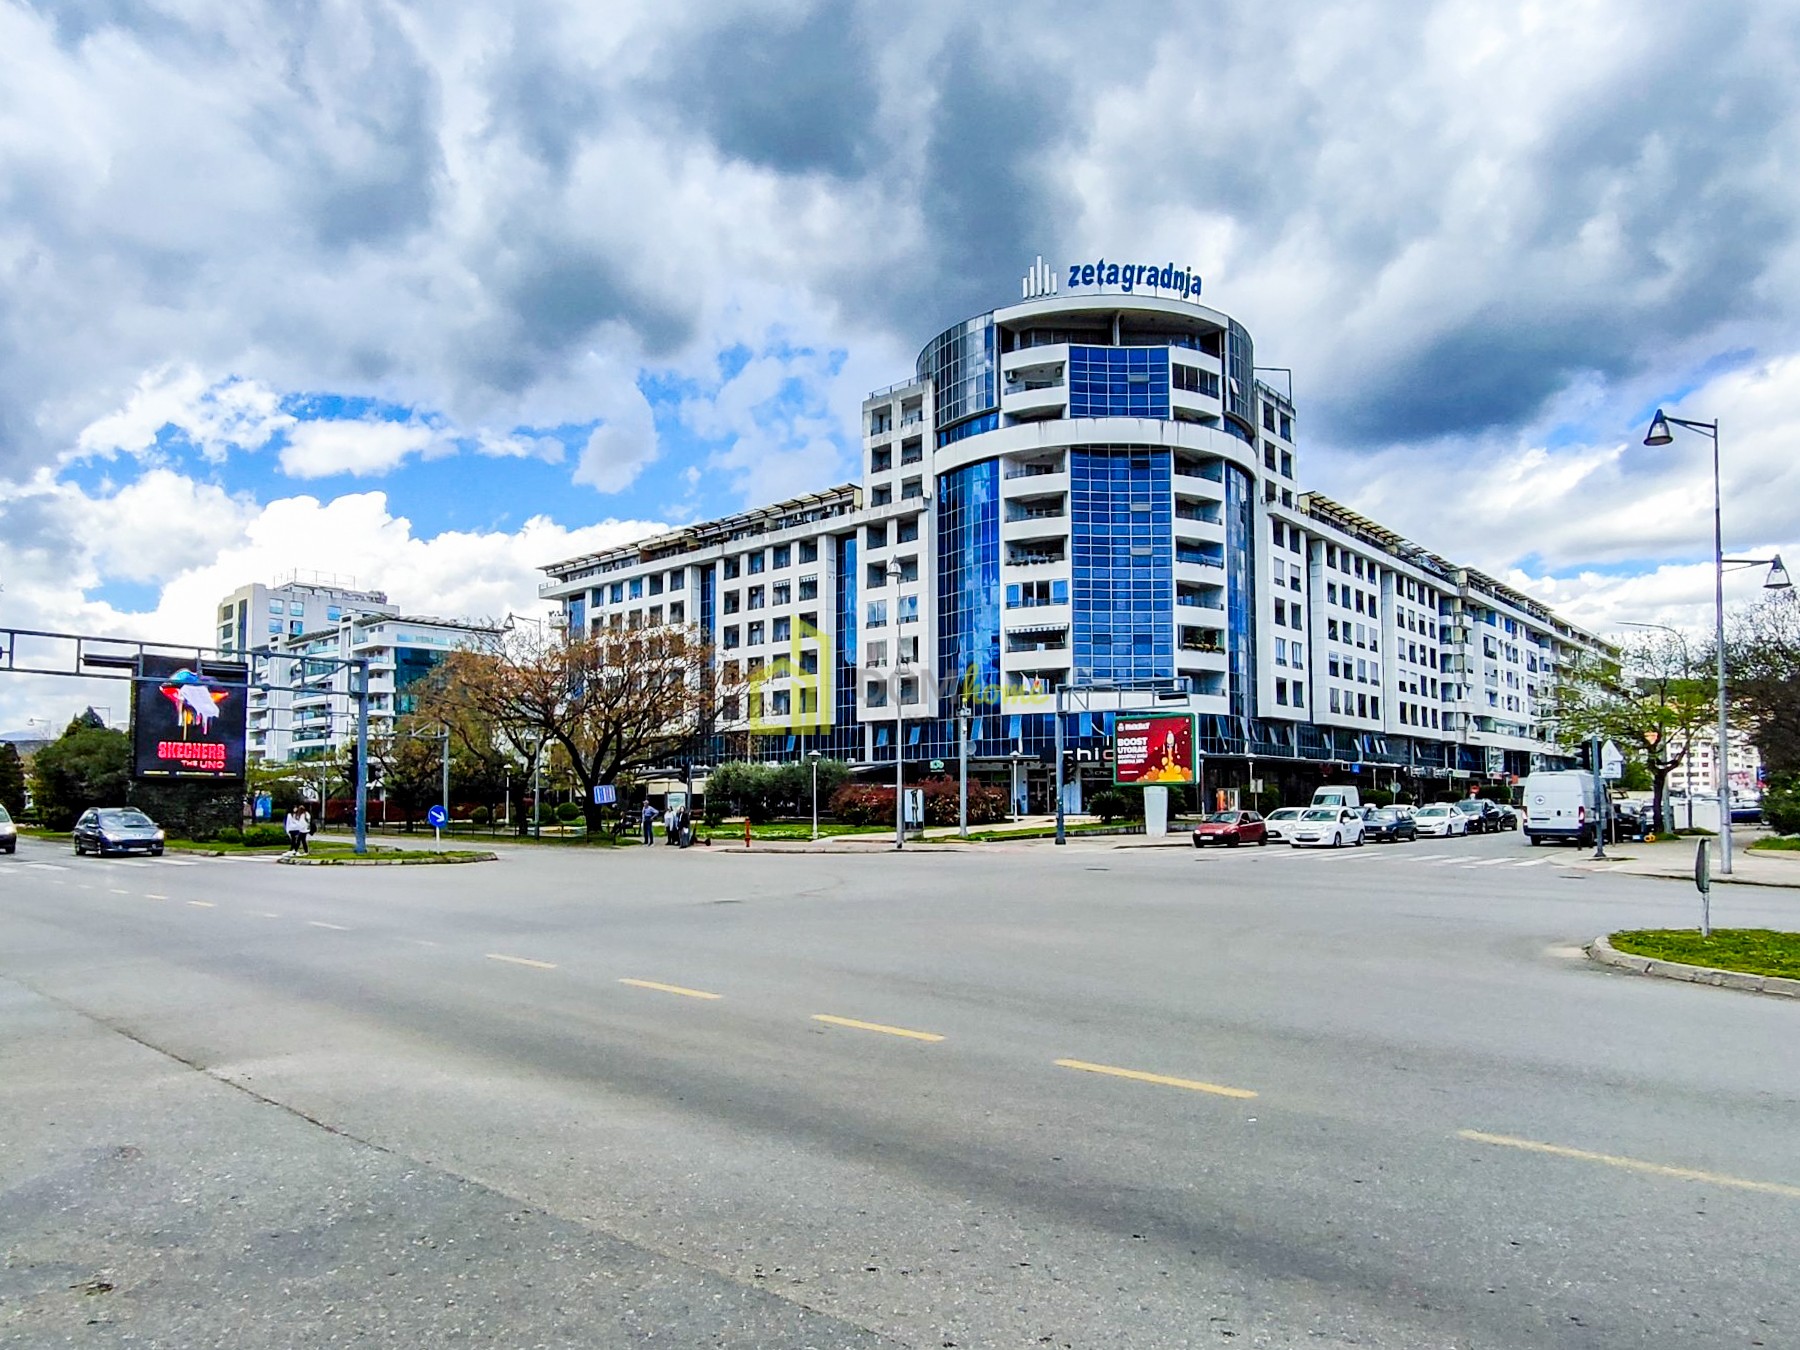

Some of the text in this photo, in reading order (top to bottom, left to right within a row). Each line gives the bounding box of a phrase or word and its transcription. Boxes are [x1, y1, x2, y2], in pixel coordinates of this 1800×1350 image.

[1068, 258, 1202, 299] zetagradnja
[1117, 737, 1148, 747] BOOST
[158, 741, 226, 760] SKECHERS
[1062, 747, 1114, 760] hic
[1117, 746, 1148, 754] UTORAK
[200, 761, 225, 769] UNO
